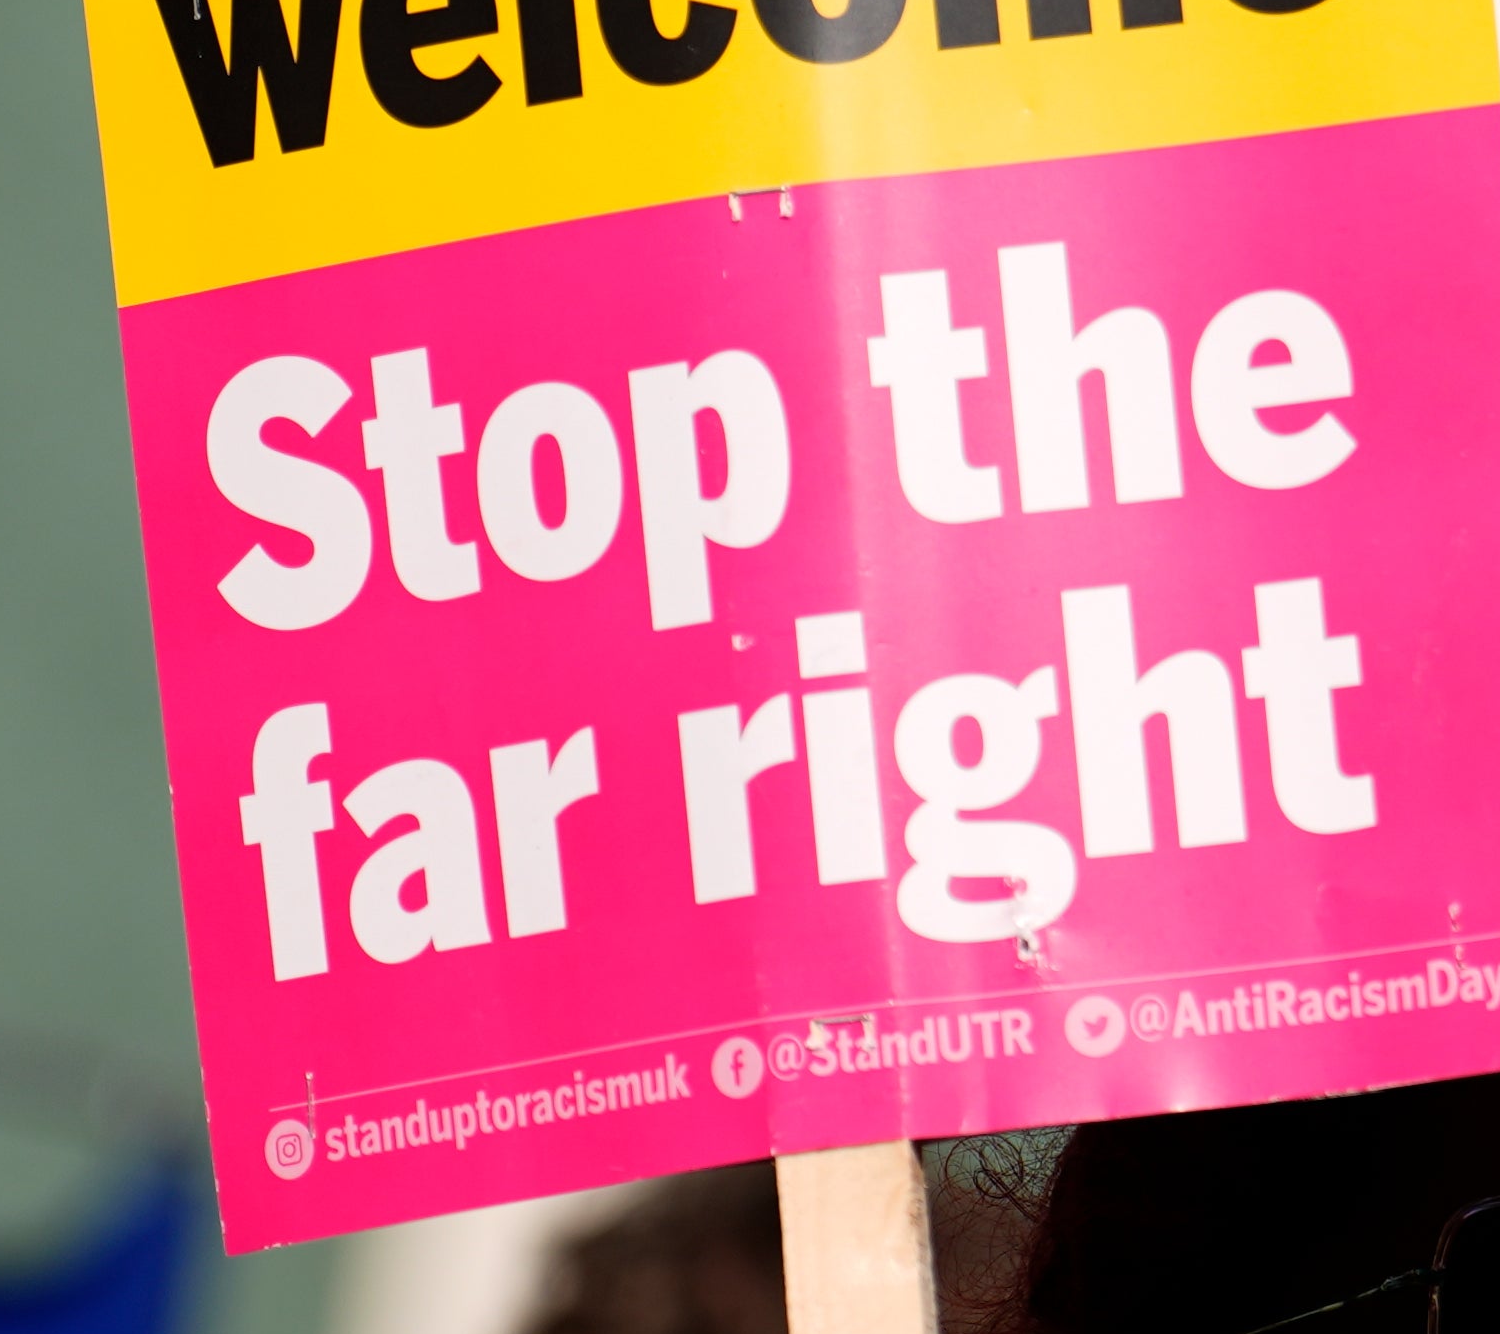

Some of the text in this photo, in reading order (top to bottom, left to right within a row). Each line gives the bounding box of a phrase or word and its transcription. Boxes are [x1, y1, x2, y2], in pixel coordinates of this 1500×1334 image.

[205, 240, 1358, 633] Stop the
[238, 576, 1379, 983] far right
[325, 1054, 691, 1162] standuptoracismuk
[766, 1008, 1034, 1082] @StandUTR
